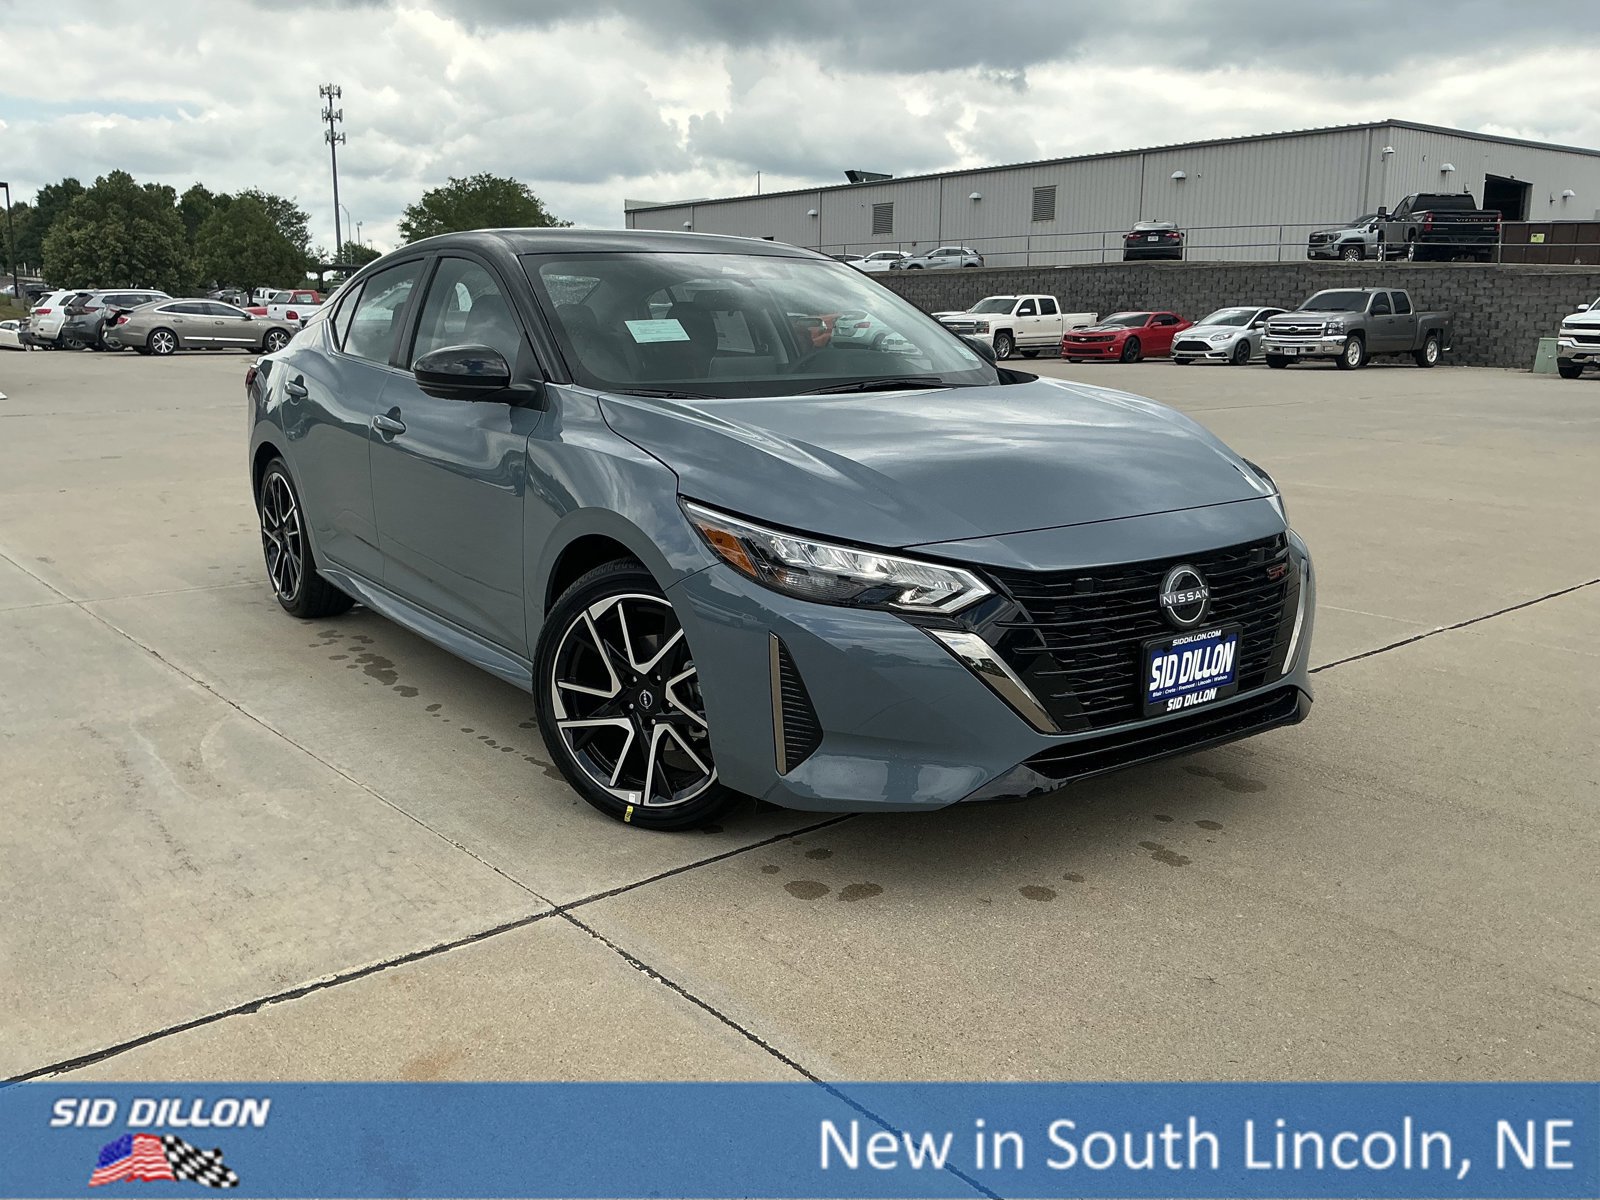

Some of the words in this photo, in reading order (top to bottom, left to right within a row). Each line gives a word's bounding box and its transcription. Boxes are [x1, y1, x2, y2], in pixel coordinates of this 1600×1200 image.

[1163, 588, 1209, 605] NISSAN
[1172, 630, 1222, 646] SIDDILLON.COM
[1149, 654, 1178, 691] SID
[1178, 641, 1236, 684] DILLON
[1166, 697, 1183, 711] SID
[1184, 688, 1217, 707] DILLON
